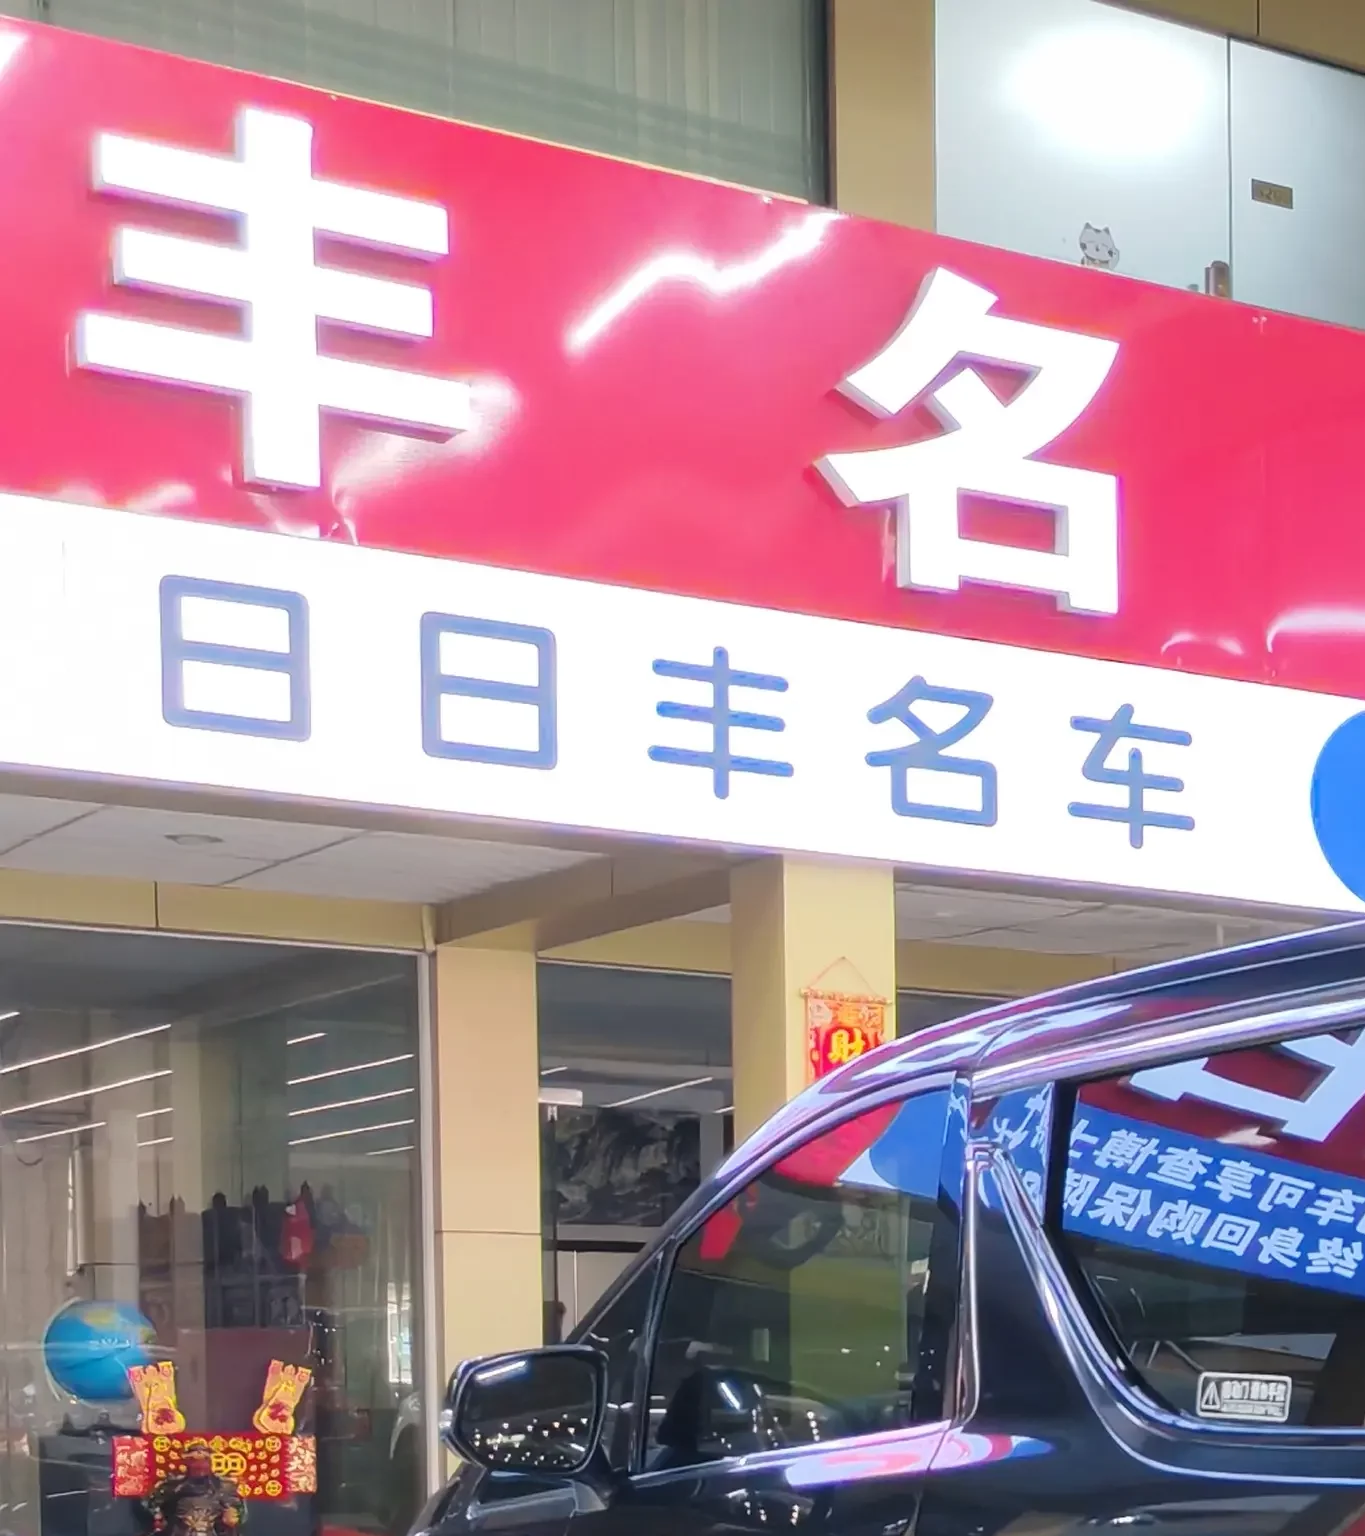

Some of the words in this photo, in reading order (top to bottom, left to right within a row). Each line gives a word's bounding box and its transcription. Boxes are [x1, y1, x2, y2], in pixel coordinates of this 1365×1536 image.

[158, 573, 1196, 849] 日日丰名车
